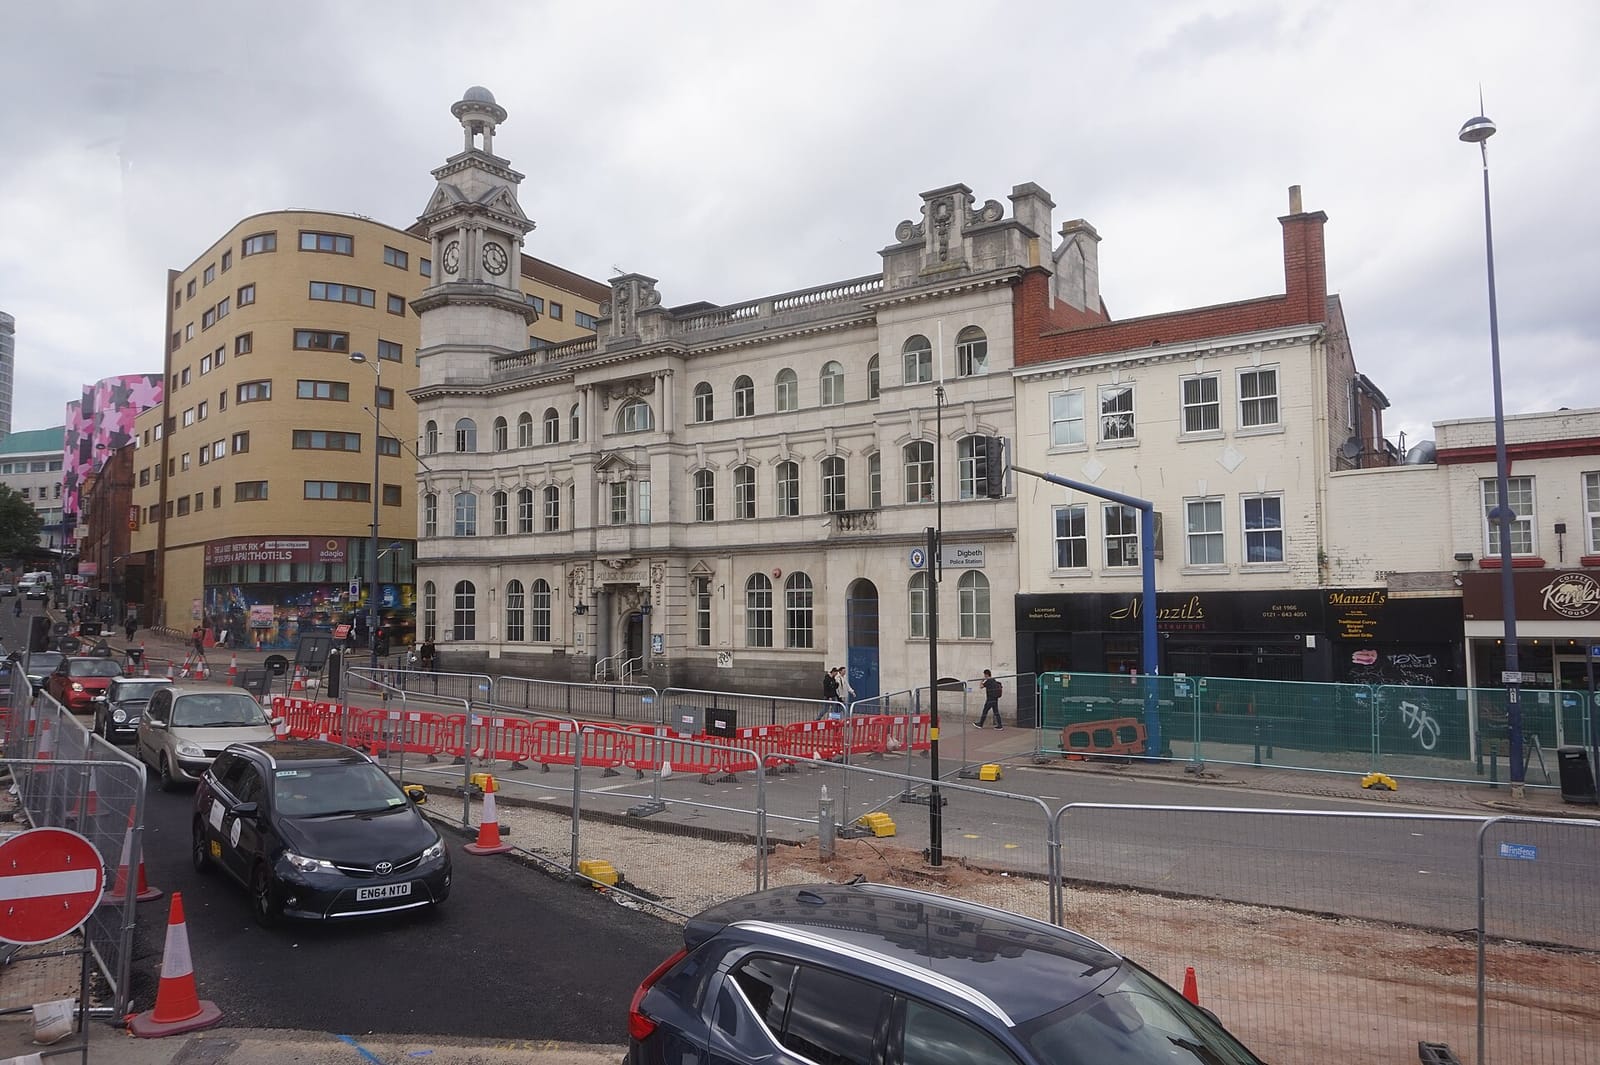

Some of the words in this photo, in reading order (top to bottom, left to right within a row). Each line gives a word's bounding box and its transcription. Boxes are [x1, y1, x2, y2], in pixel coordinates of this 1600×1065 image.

[319, 550, 344, 558] adagio
[957, 550, 982, 558] Digbeth
[1559, 575, 1590, 583] COFFEE
[1329, 591, 1386, 605] Manzil's
[1110, 596, 1205, 619] Mnzil's
[361, 888, 386, 899] EN64
[389, 884, 408, 896] NTO
